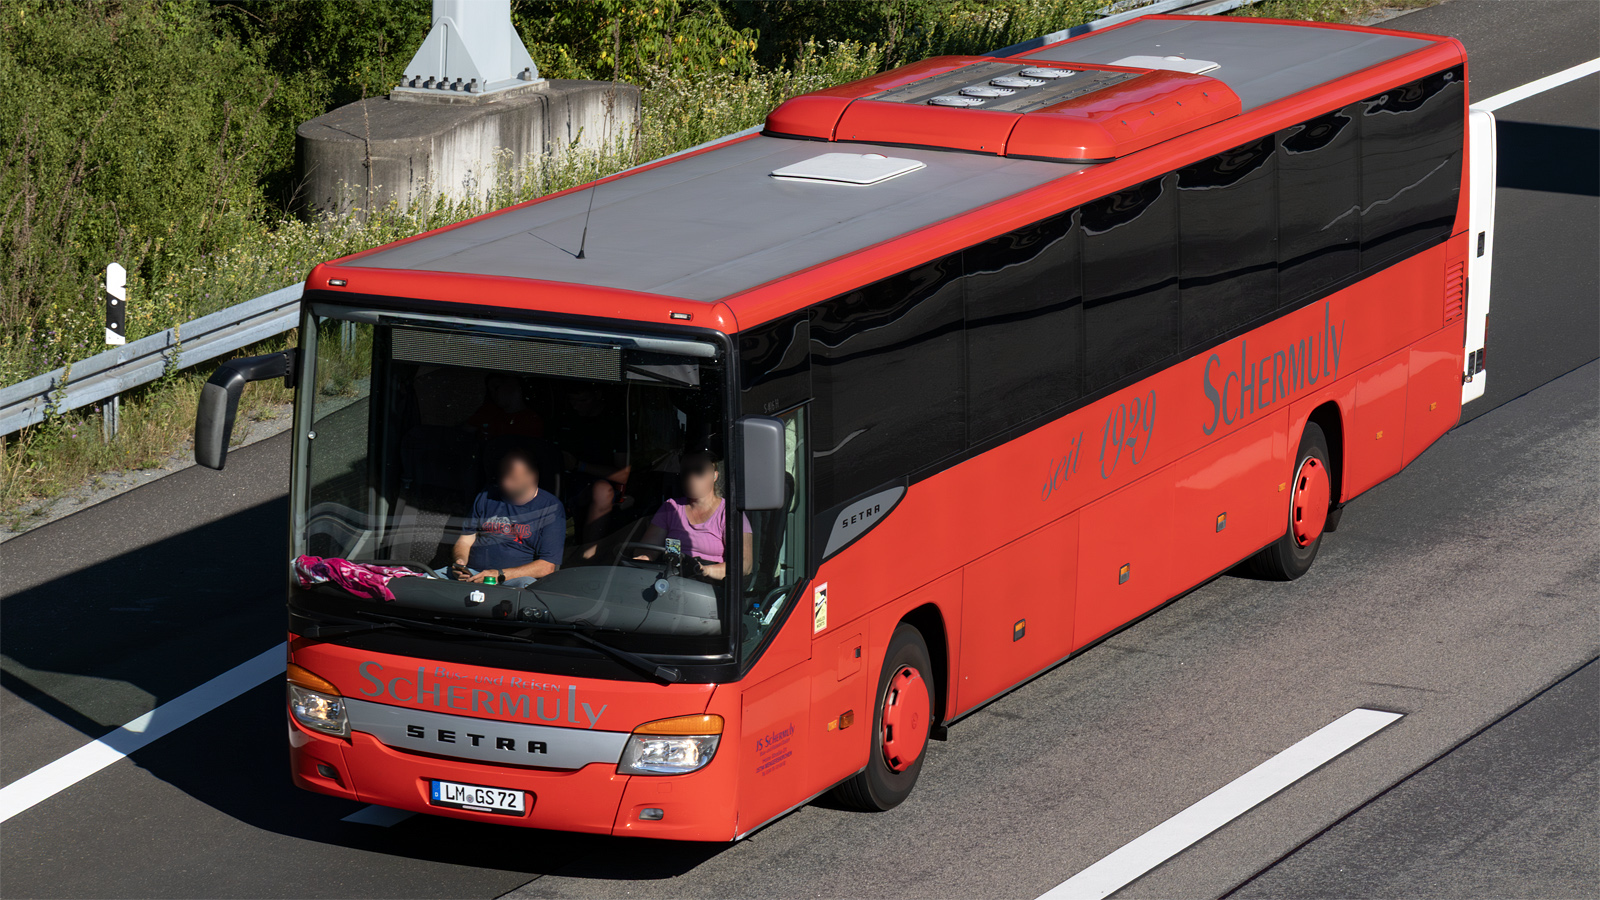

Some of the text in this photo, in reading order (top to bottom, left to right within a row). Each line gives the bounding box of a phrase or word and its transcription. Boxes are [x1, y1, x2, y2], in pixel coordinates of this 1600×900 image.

[1041, 389, 1156, 501] seit 1929
[842, 504, 880, 528] SETRA
[406, 724, 547, 754] SETRA
[445, 784, 517, 808] LM GS 72
